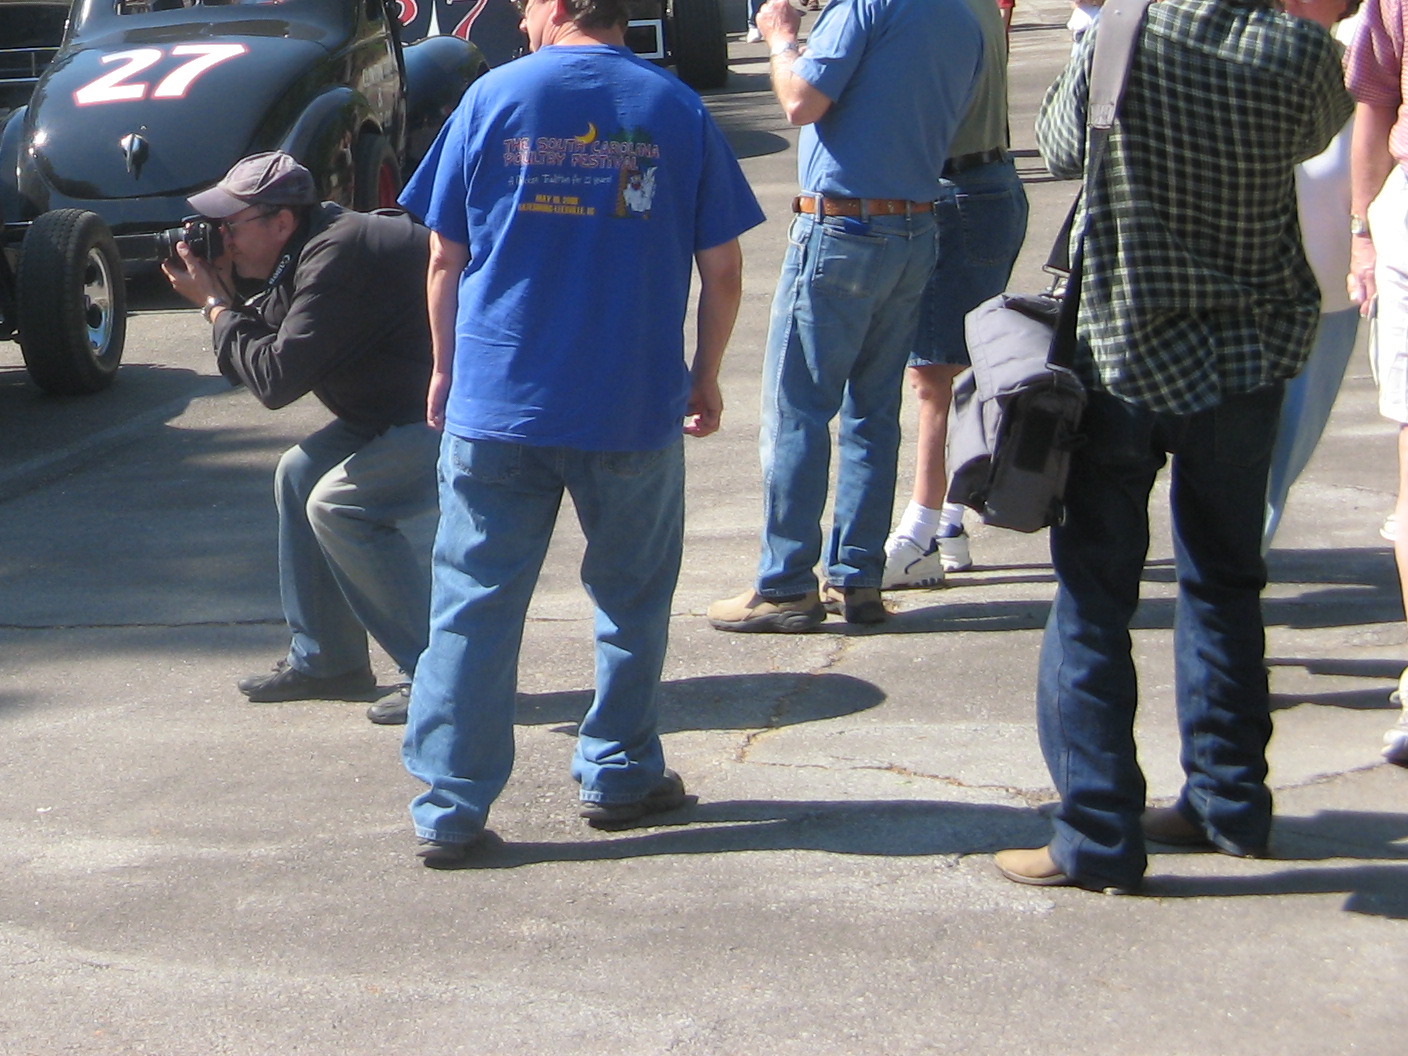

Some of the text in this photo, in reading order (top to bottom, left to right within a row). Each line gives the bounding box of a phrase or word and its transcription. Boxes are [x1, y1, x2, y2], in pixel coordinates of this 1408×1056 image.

[71, 42, 250, 107] 27
[503, 136, 661, 159] THE SOUTH CAROLINA
[503, 150, 639, 170] POULTRY FESTIVAL
